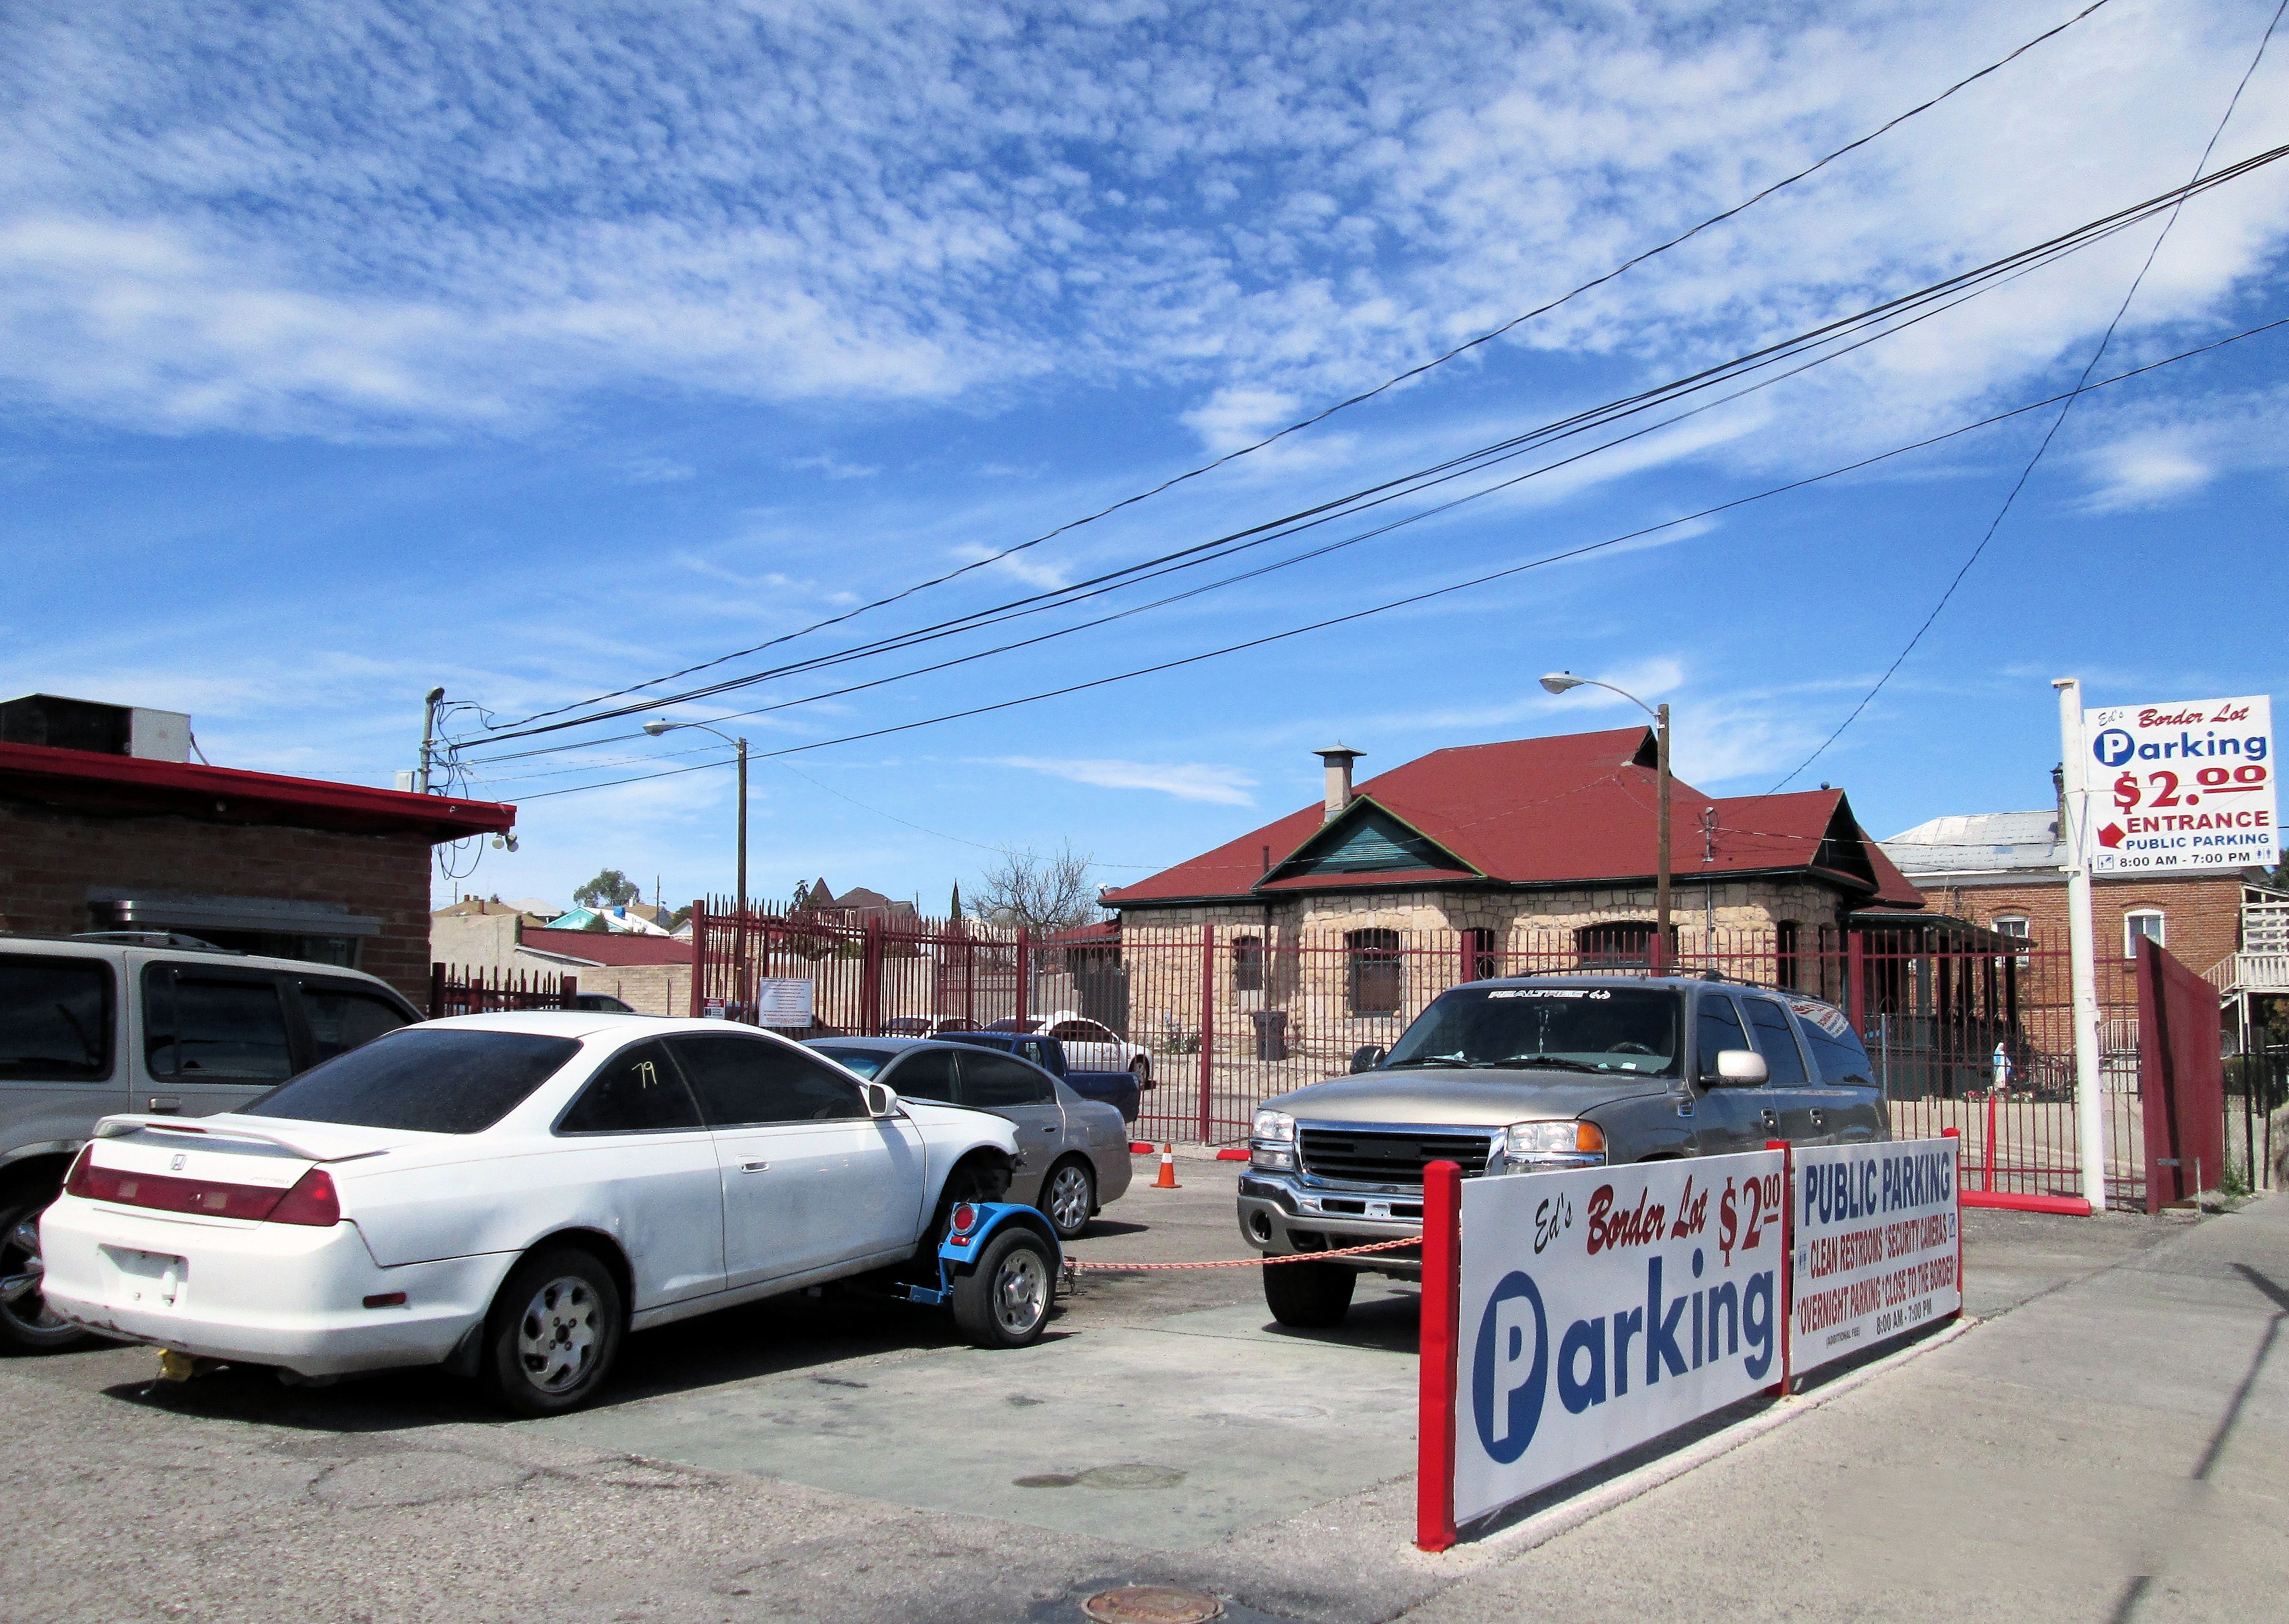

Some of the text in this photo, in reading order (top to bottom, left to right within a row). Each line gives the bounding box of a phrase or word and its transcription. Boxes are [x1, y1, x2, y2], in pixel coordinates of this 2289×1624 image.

[2098, 703, 2249, 728] Ed's Border Lot
[2093, 728, 2267, 767] Parking
[2127, 810, 2269, 833] ENTRANCE
[2119, 856, 2150, 867] 8:00
[2155, 855, 2177, 865] AM
[2193, 854, 2223, 864] 7:00
[2229, 852, 2250, 862] PM
[2126, 833, 2269, 850] PUBLIC PARKING
[1805, 1151, 1950, 1226] PUBLIC PARKING
[1534, 1192, 1573, 1254] Ed's
[1587, 1184, 1665, 1255] Border
[1670, 1174, 1709, 1239] Lot
[1810, 1236, 1837, 1279] CLEAN
[1840, 1226, 1883, 1272] RESTROOMS
[1850, 1276, 1880, 1318] PARKING
[1907, 1266, 1917, 1298] TO
[1918, 1262, 1929, 1295] THE
[1877, 1313, 1891, 1335] 8:00
[1893, 1309, 1904, 1329] AM
[1908, 1302, 1922, 1323] 7:00
[1923, 1297, 1932, 1317] PM
[1472, 1248, 1774, 1464] Parking
